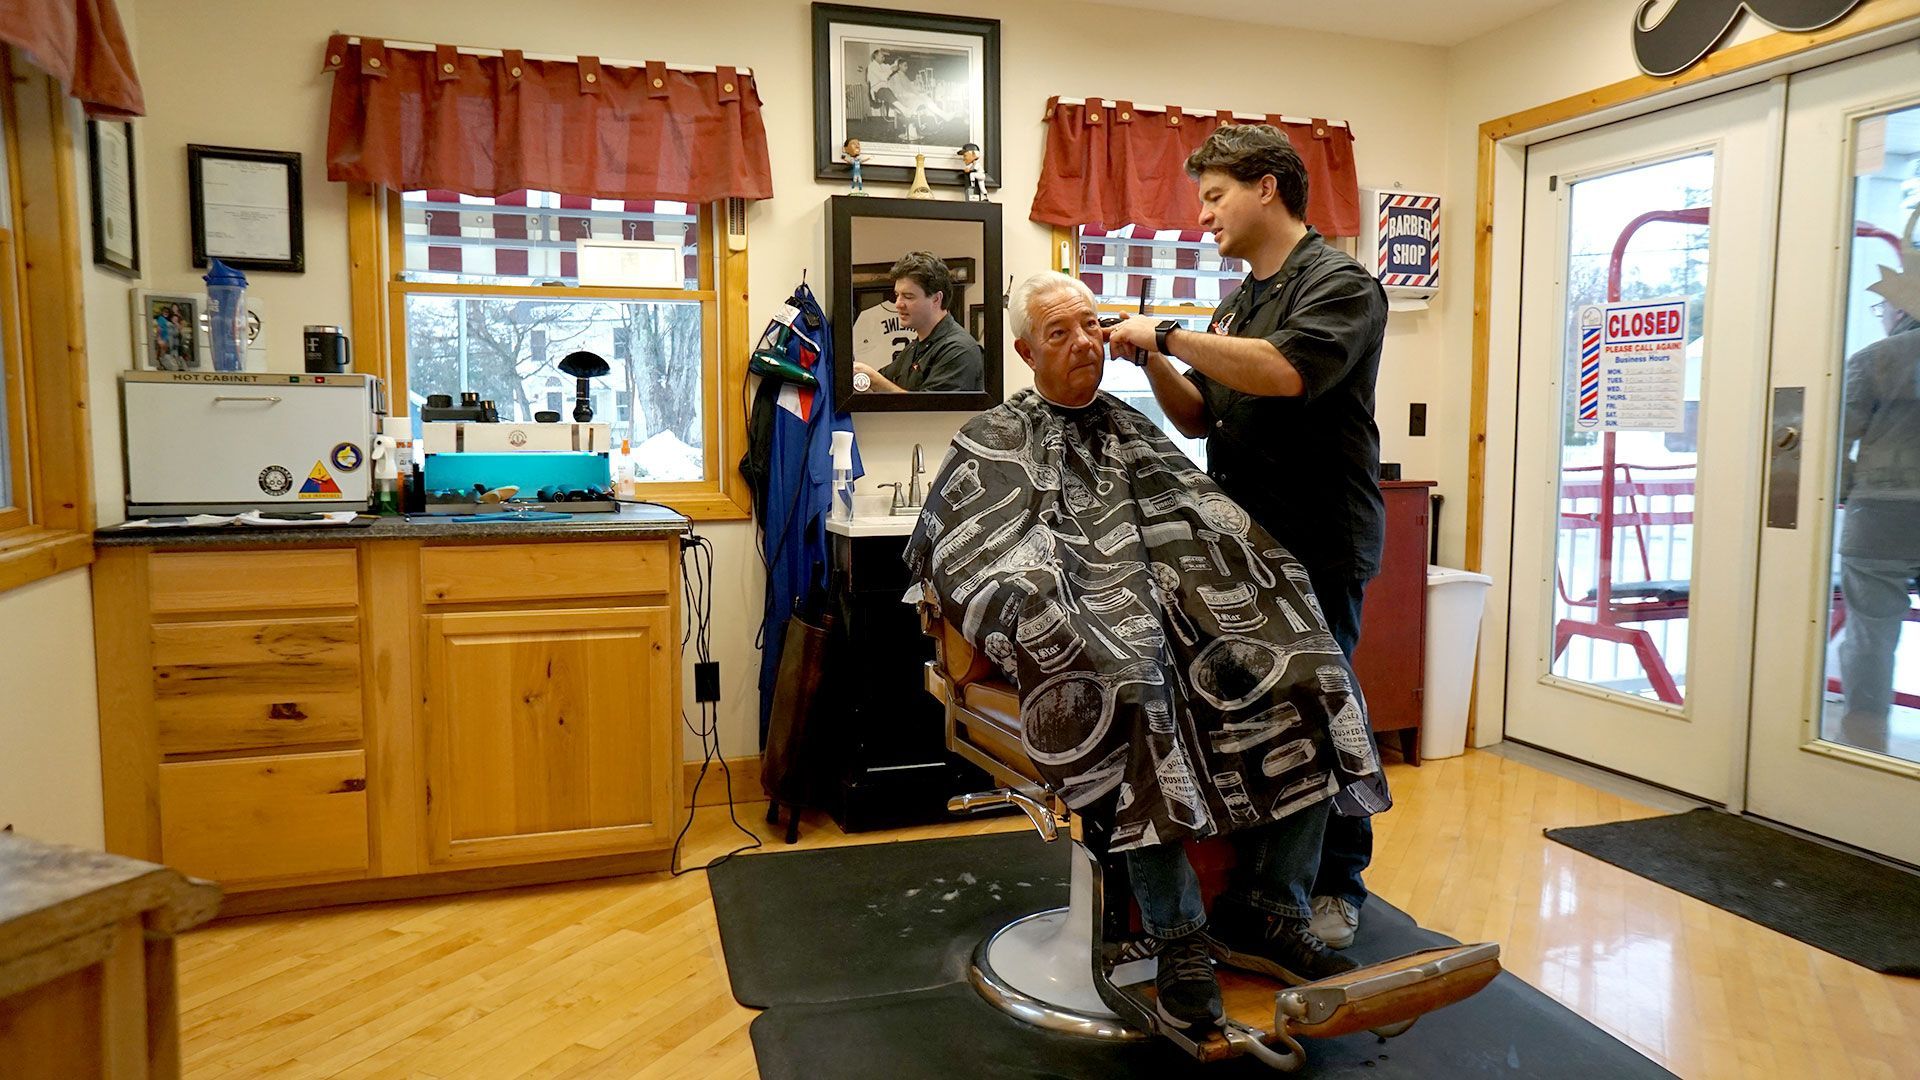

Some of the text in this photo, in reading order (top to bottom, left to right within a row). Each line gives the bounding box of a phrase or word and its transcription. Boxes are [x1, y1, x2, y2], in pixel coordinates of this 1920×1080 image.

[1389, 215, 1431, 241] BARBER
[1393, 244, 1426, 265] SHOP
[1609, 310, 1680, 338] CLOSED
[1605, 342, 1682, 353] PLEASE CALL AGAIN!
[1615, 354, 1670, 364] Business Hours
[173, 374, 259, 383] HOT CABINET
